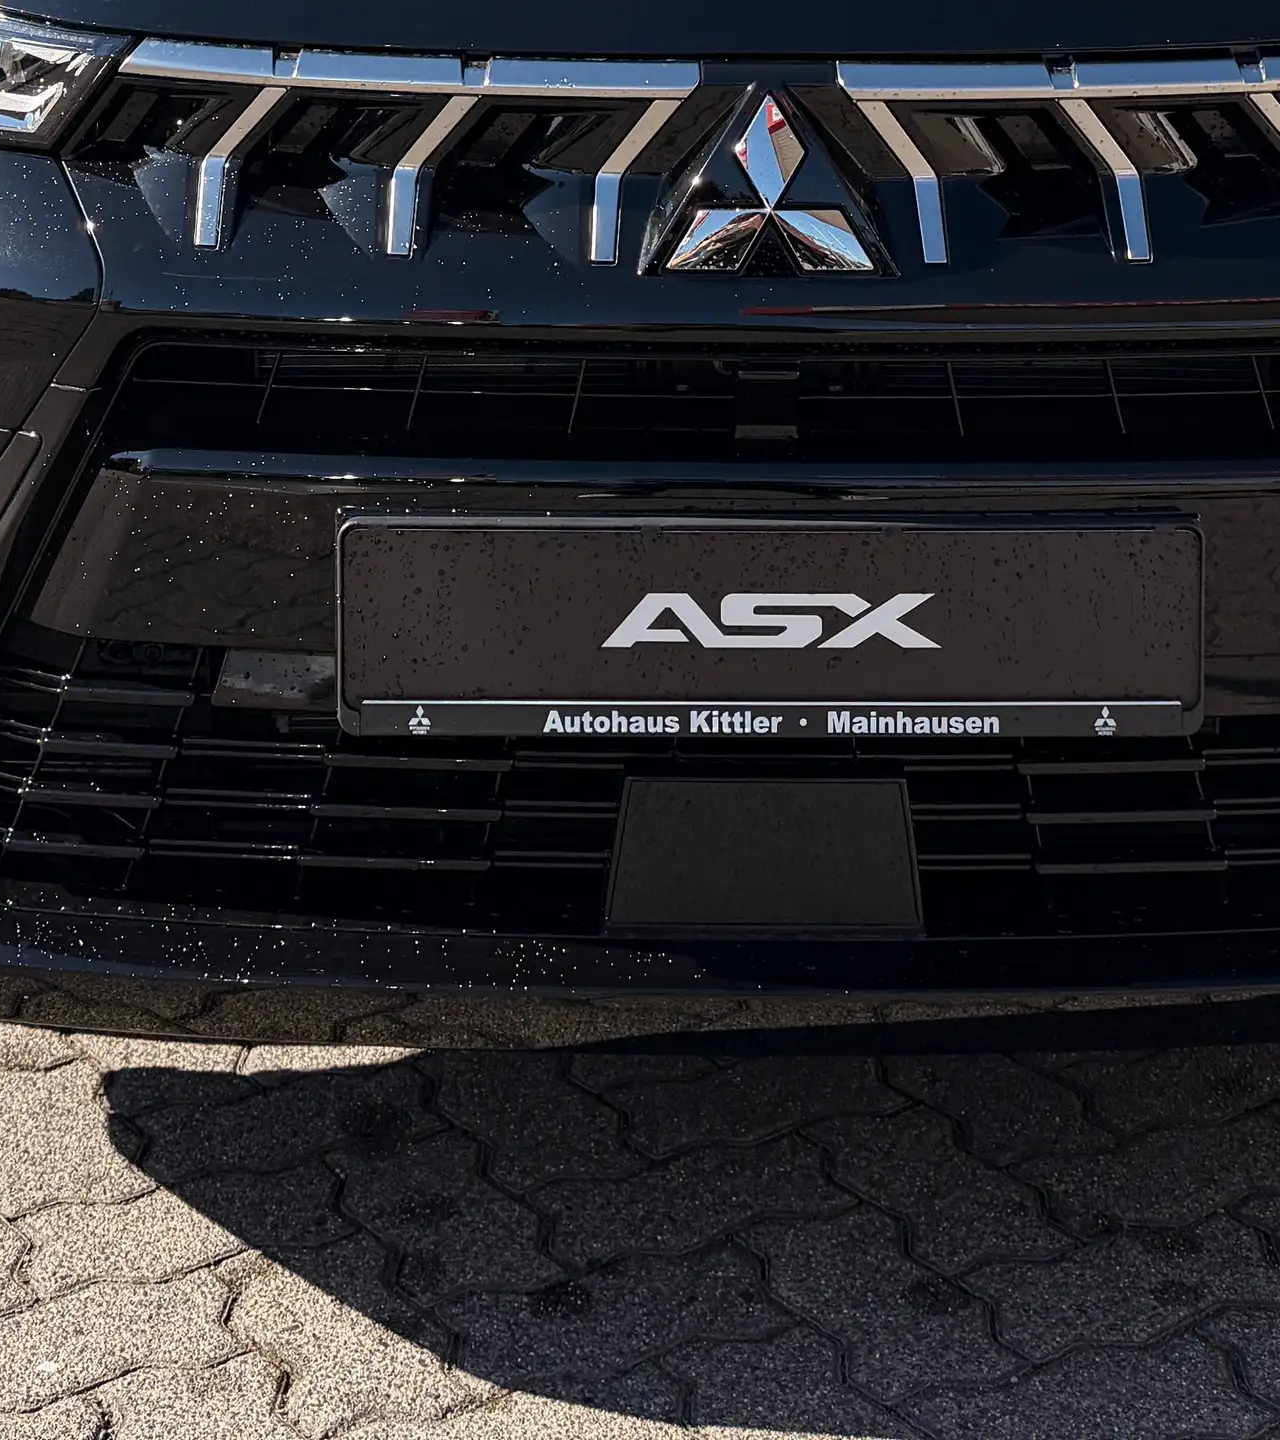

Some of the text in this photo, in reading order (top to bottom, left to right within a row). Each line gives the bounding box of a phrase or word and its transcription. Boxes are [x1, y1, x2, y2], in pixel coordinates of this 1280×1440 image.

[601, 593, 942, 648] ASX
[543, 710, 1000, 734] Autohaus Kittler Mainhausen
